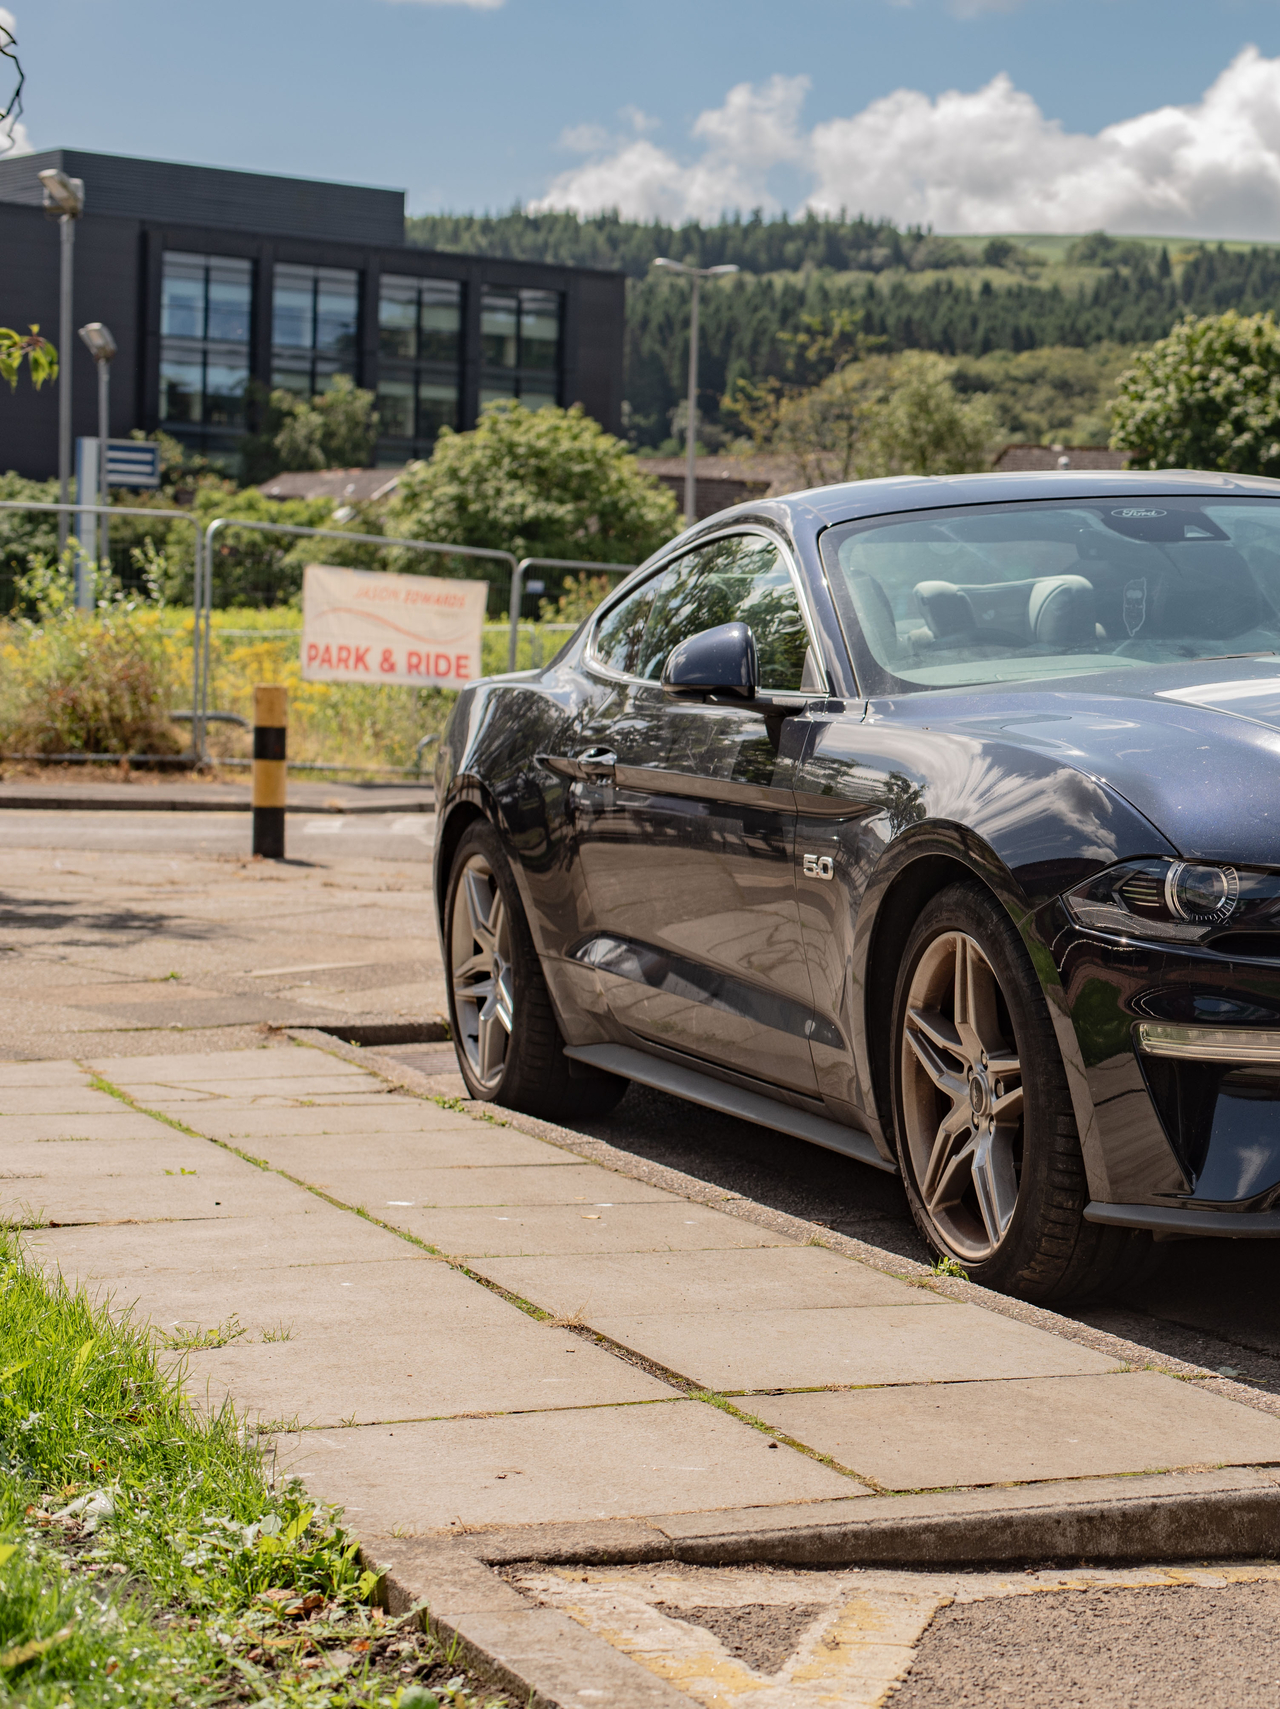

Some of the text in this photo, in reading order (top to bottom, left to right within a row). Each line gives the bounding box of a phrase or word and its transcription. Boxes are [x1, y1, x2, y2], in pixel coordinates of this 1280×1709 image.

[1121, 508, 1158, 517] Ford
[307, 644, 470, 678] PARK & RIDE
